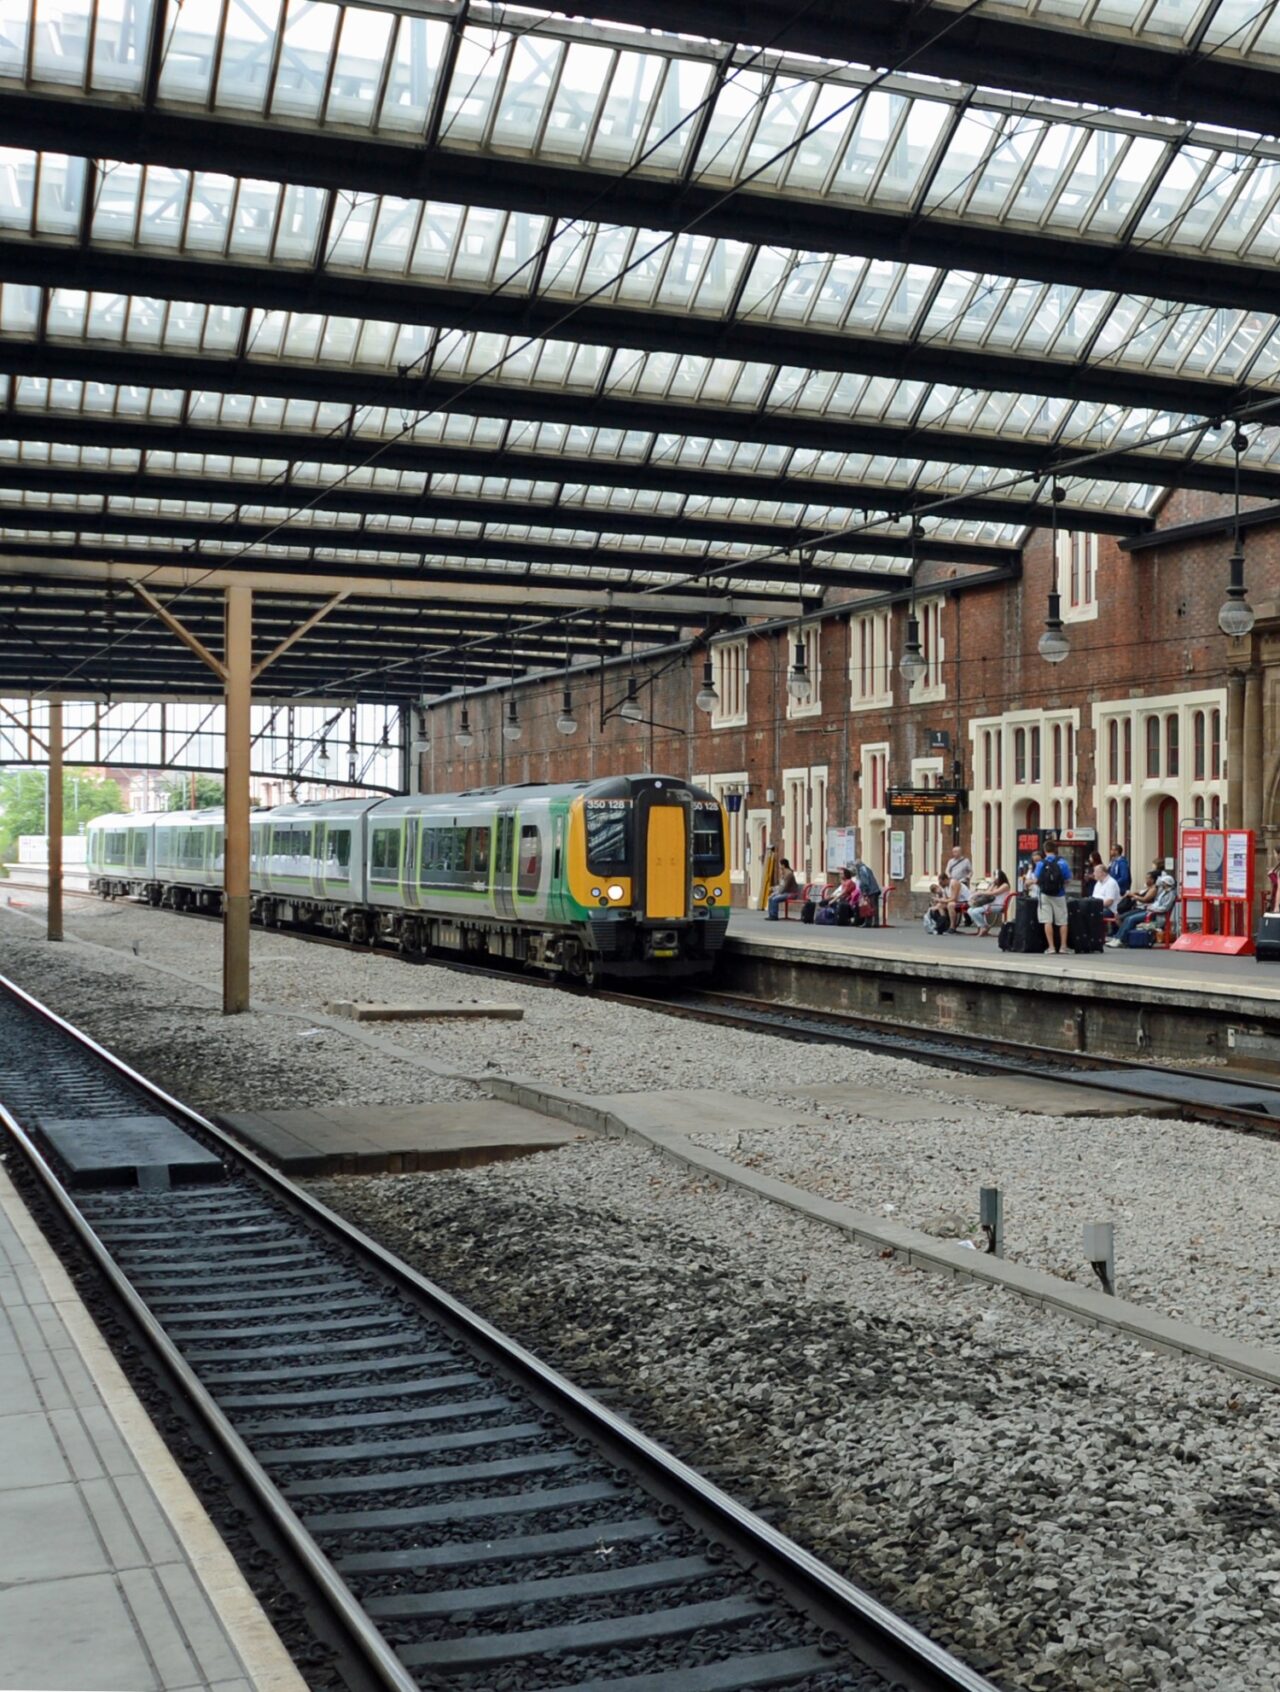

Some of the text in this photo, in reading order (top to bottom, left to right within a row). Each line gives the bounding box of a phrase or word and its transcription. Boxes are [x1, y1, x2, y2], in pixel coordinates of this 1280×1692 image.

[935, 732, 942, 742] 1
[587, 800, 625, 809] 350 128
